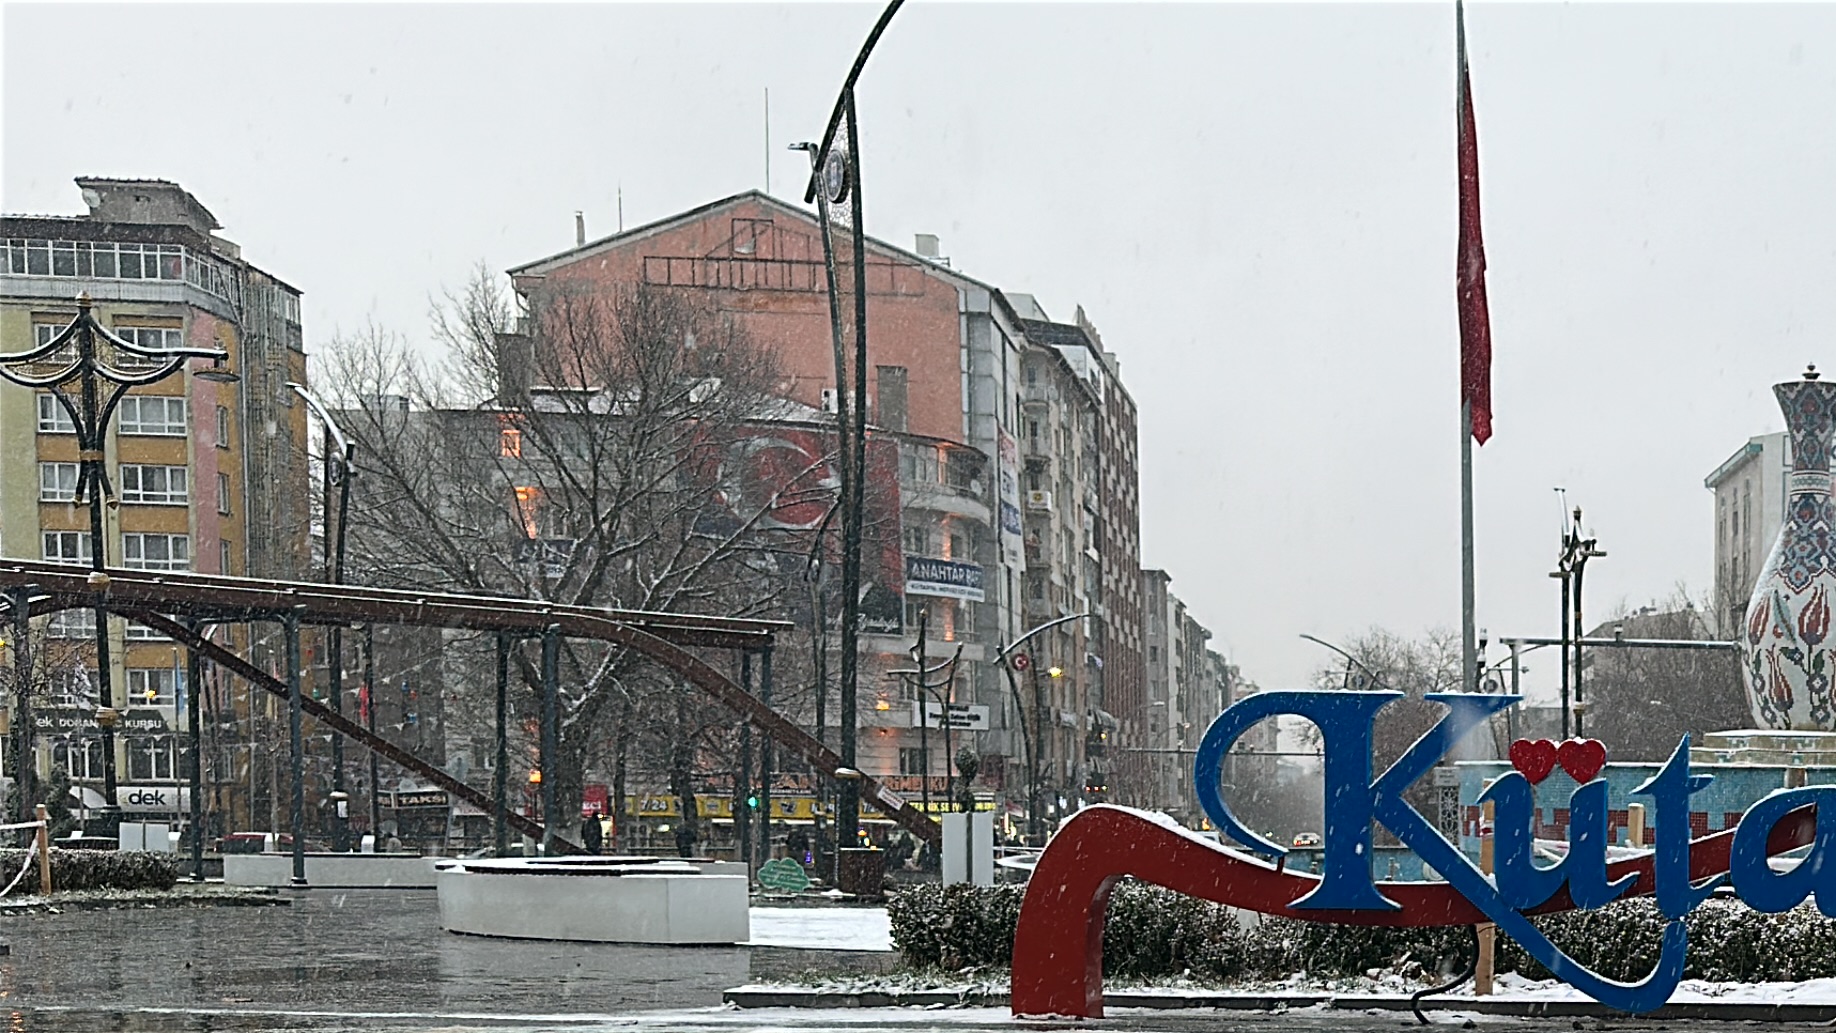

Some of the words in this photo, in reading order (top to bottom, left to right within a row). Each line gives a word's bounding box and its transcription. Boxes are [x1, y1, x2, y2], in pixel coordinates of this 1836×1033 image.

[911, 562, 965, 582] ANAHTAR
[125, 719, 162, 729] KURSU
[128, 789, 166, 805] dek
[640, 799, 668, 812] 7/24
